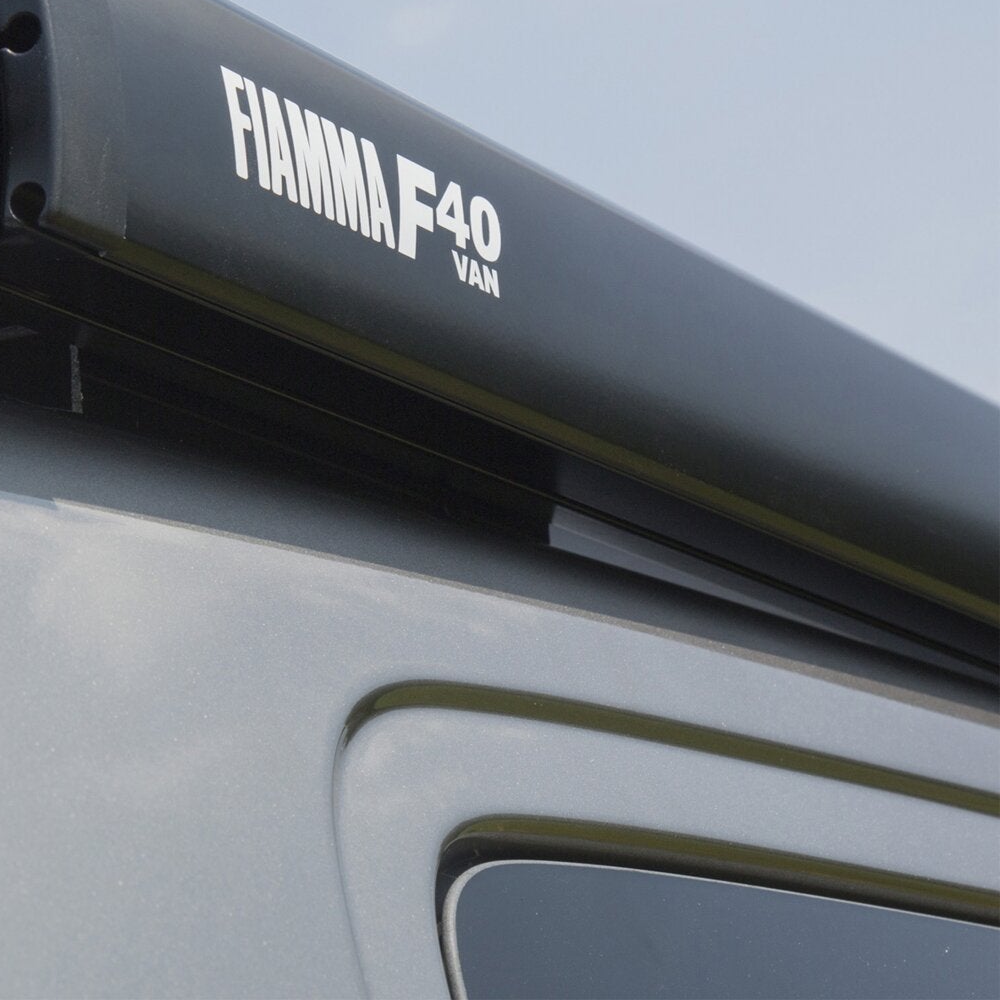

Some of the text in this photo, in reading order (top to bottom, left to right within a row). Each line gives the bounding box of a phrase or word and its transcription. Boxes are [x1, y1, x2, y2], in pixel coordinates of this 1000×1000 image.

[220, 65, 502, 263] FIAMMA F40
[451, 249, 501, 299] VAN
